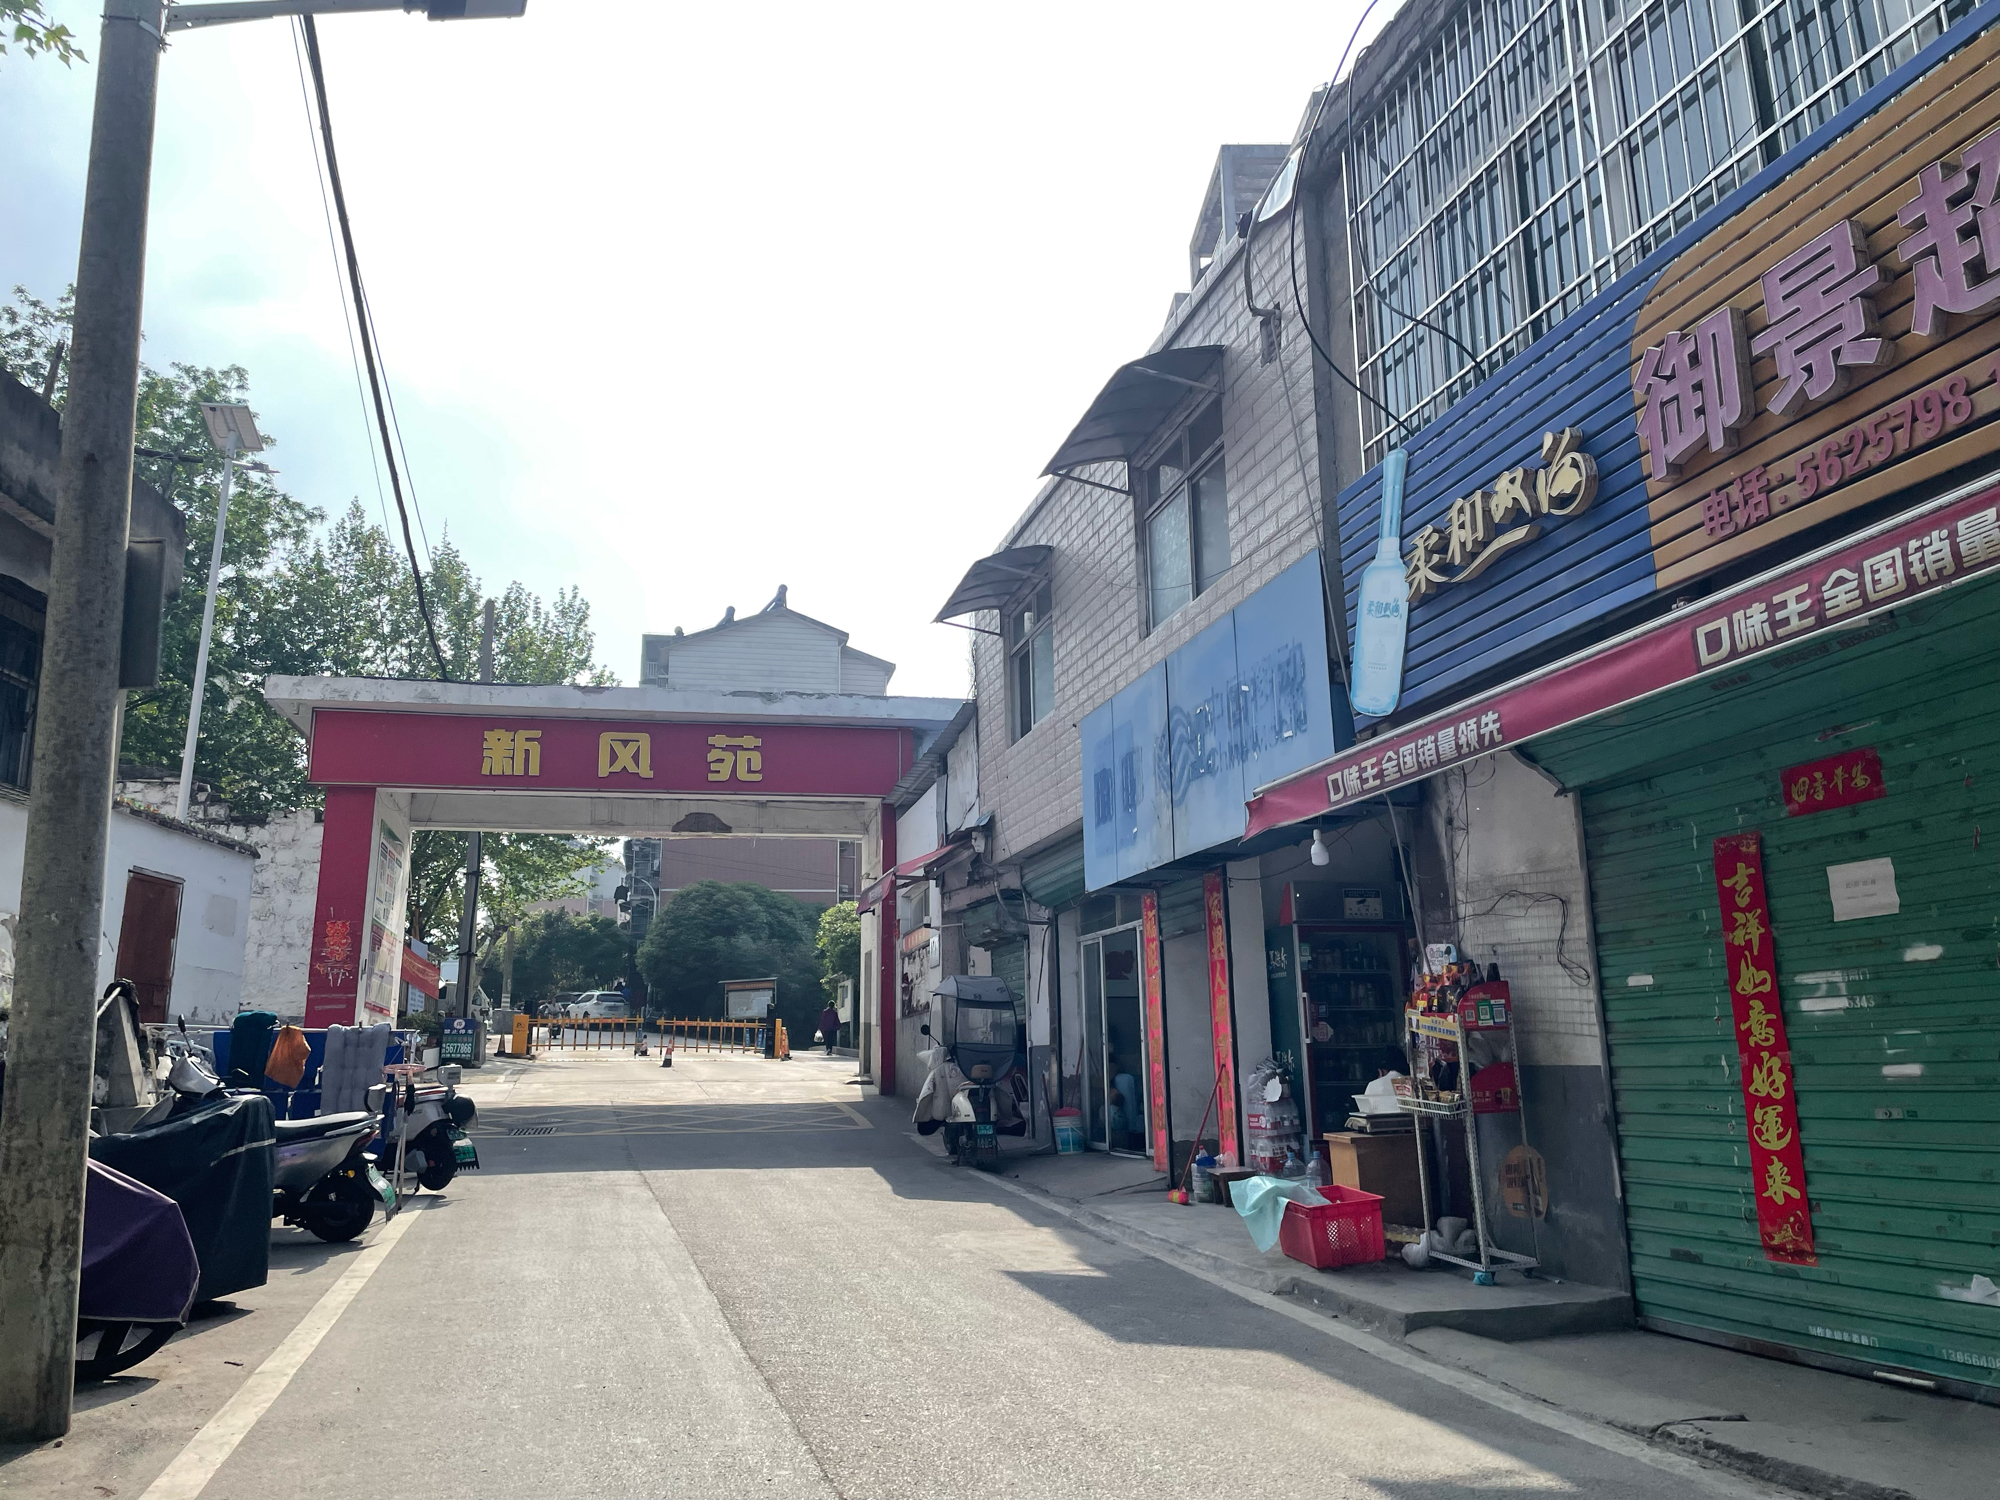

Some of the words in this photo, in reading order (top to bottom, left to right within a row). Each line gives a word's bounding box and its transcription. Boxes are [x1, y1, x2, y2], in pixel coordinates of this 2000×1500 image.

[481, 728, 763, 782] 新风苑
[1327, 710, 1502, 803] 口味王全国销量领先
